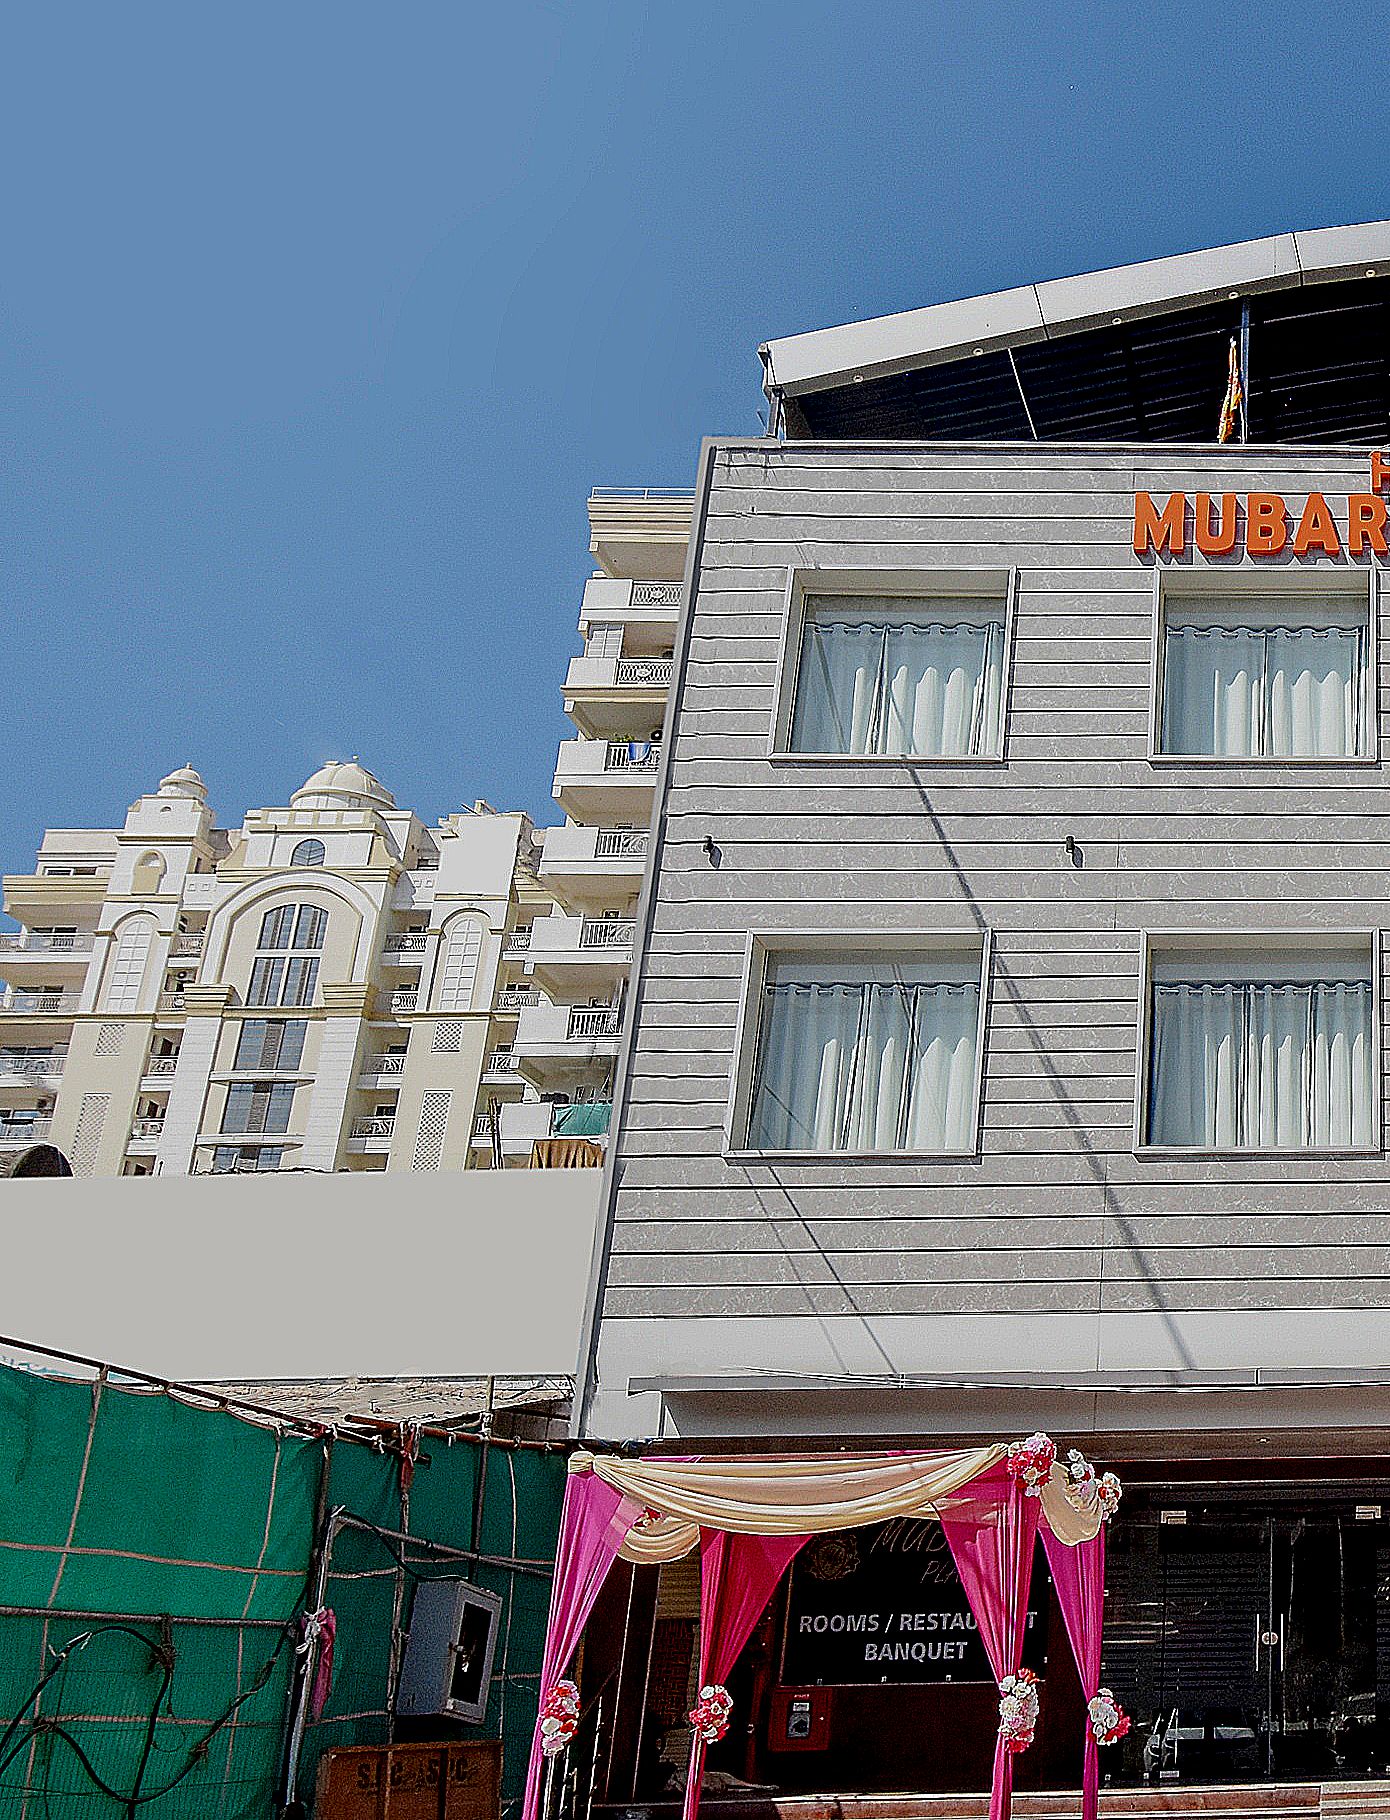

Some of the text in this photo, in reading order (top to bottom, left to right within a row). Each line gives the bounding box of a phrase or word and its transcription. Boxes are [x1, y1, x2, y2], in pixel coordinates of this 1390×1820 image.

[869, 1518, 949, 1553] MUB
[799, 1613, 880, 1634] ROOMS
[899, 1611, 1038, 1633] RESTAUT
[864, 1641, 969, 1663] BANQUET
